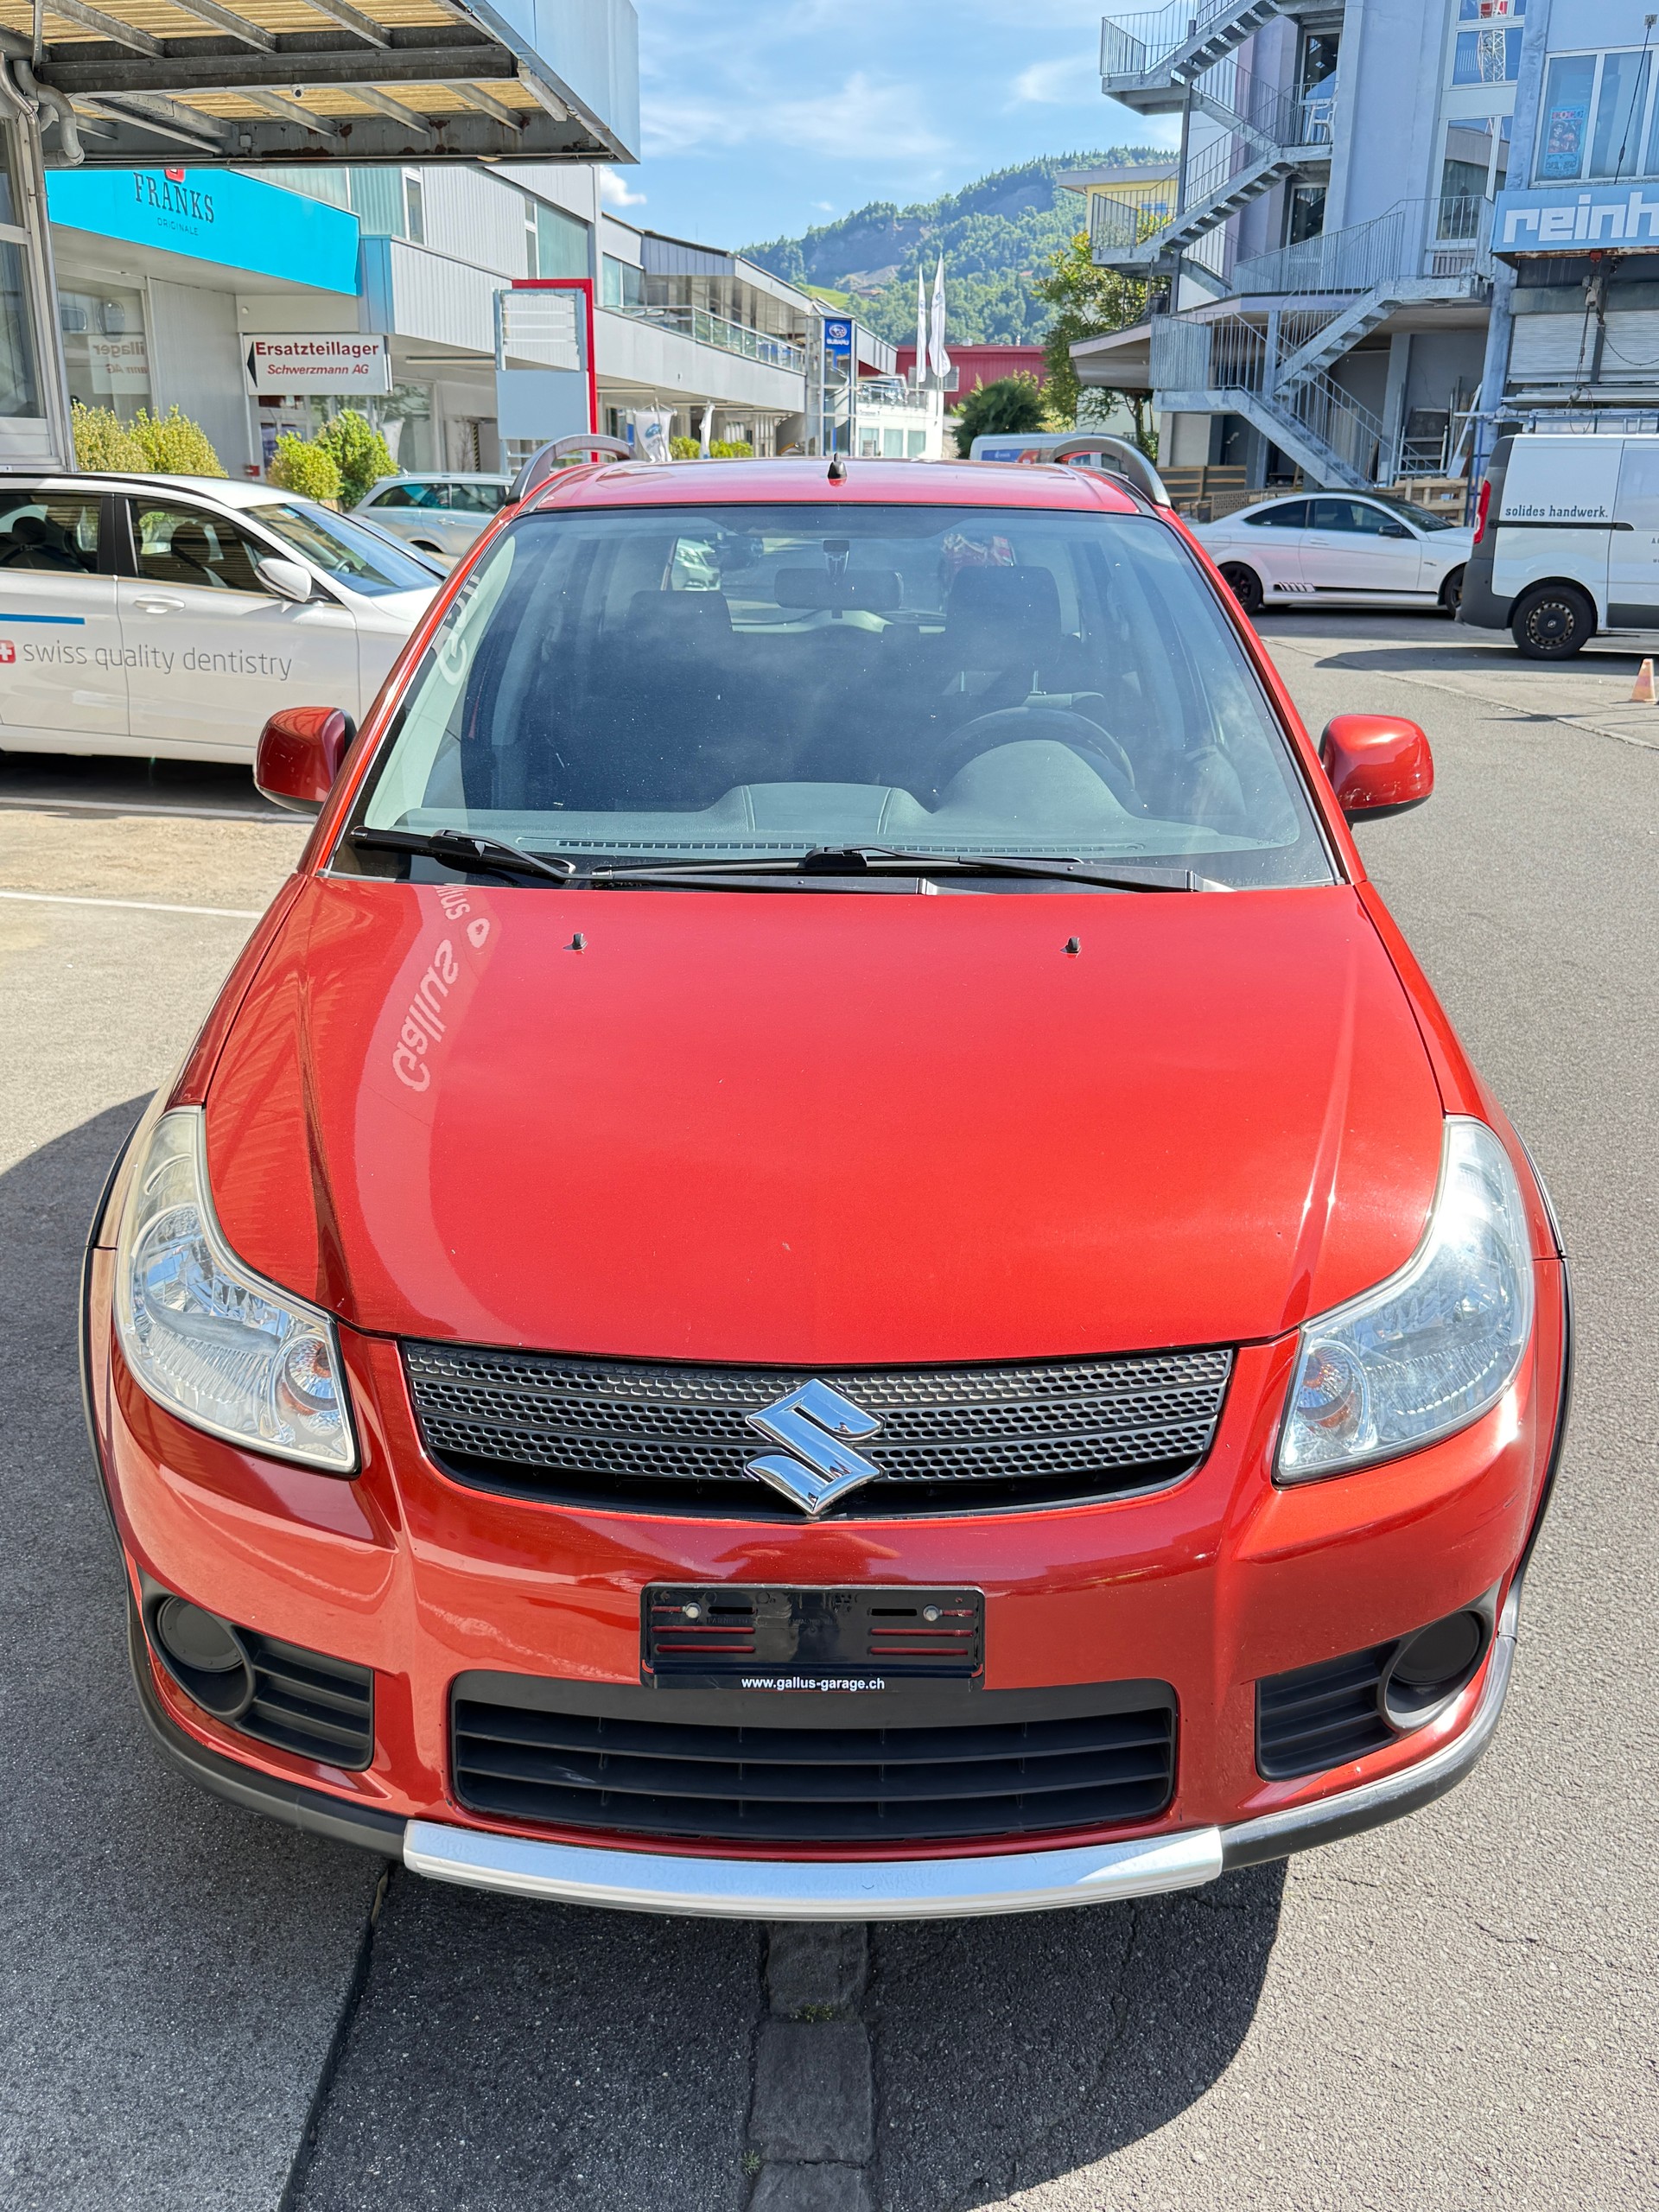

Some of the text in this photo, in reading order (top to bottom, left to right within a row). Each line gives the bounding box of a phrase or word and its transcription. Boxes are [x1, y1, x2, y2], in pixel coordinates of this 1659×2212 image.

[133, 172, 214, 224] FRANKS
[157, 216, 200, 237] ORIGINALE
[1503, 191, 1659, 244] reinh
[255, 340, 379, 359] Ersatzteillager
[267, 364, 370, 375] Schwerzmann AG
[1505, 505, 1609, 518] solides handwerk.
[22, 639, 292, 682] swiss quality dentistry
[741, 1676, 886, 1693] www.gallus-garage.ch
